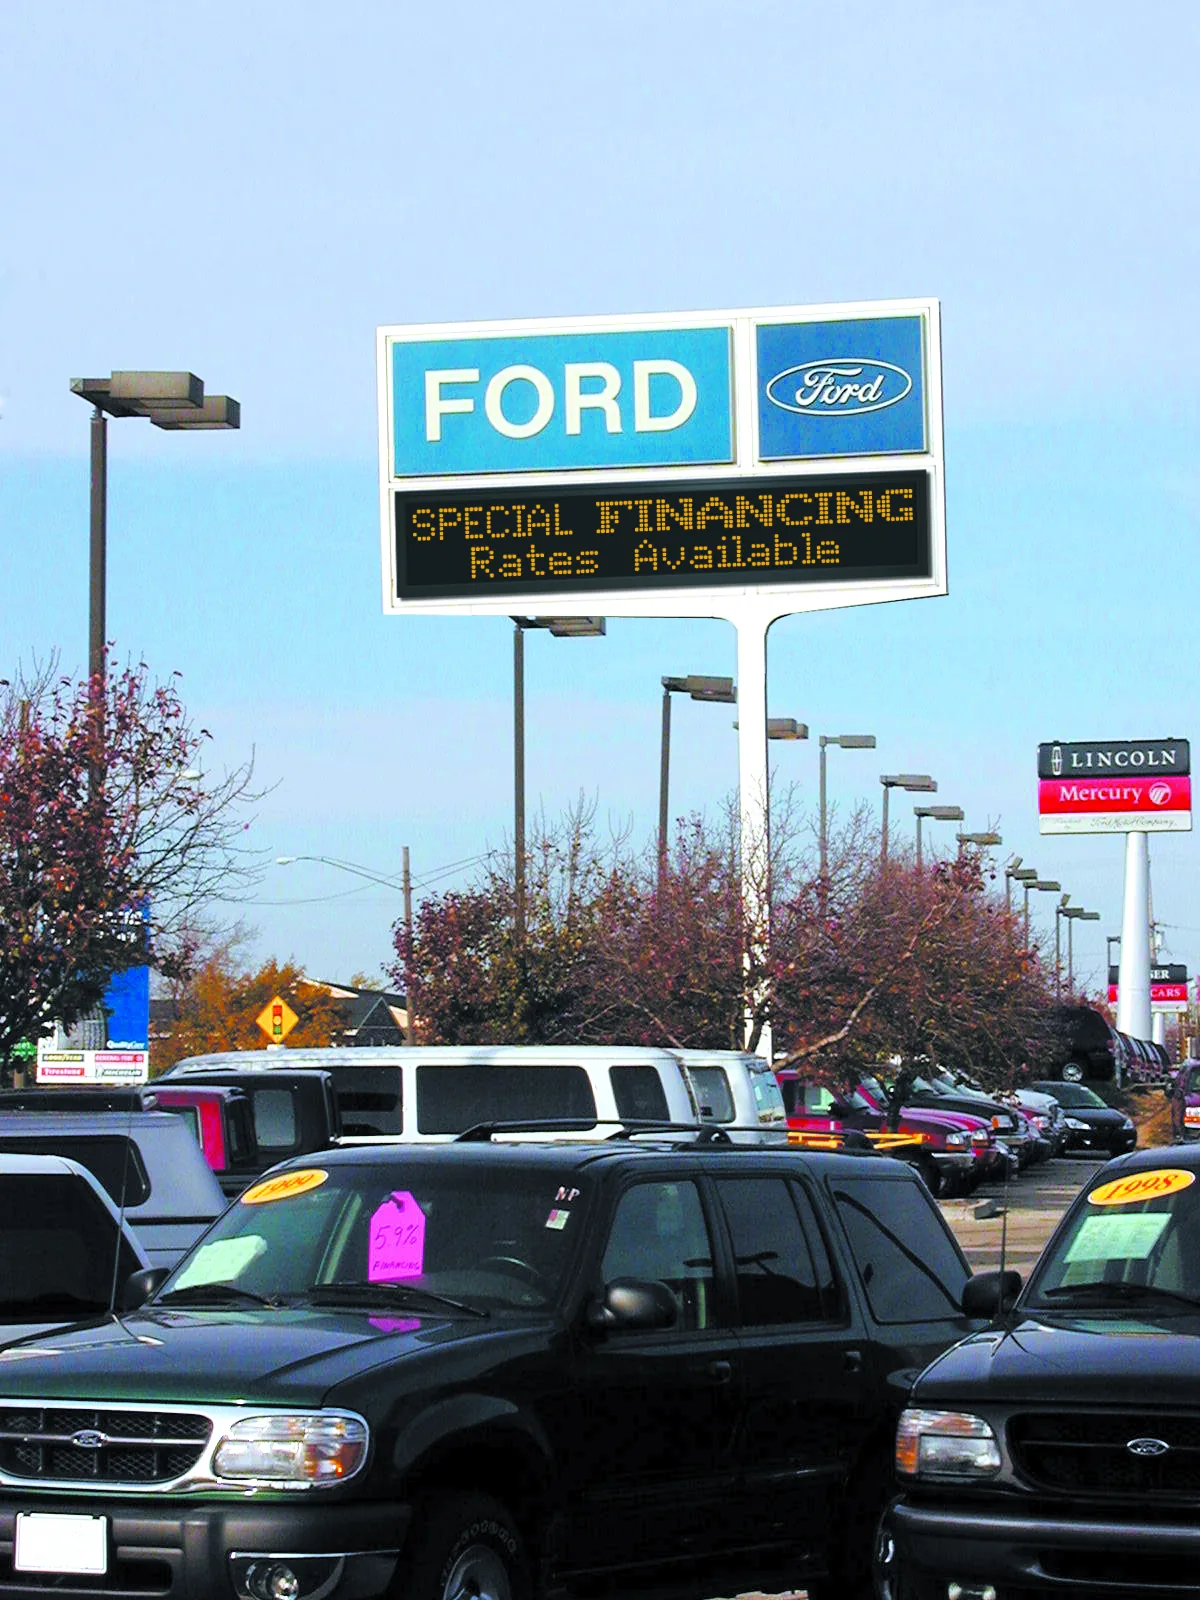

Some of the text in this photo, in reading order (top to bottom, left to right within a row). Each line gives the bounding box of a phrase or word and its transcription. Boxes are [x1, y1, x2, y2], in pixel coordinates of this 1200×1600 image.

[424, 360, 698, 442] FORD
[795, 367, 885, 406] Ford
[412, 488, 914, 541] SPECIAL FINANCING
[470, 532, 840, 579] Rates Available
[1071, 750, 1176, 768] LINCOLN
[1059, 785, 1142, 804] Mercury
[1151, 987, 1181, 999] CARS
[1104, 1173, 1179, 1200] 1998
